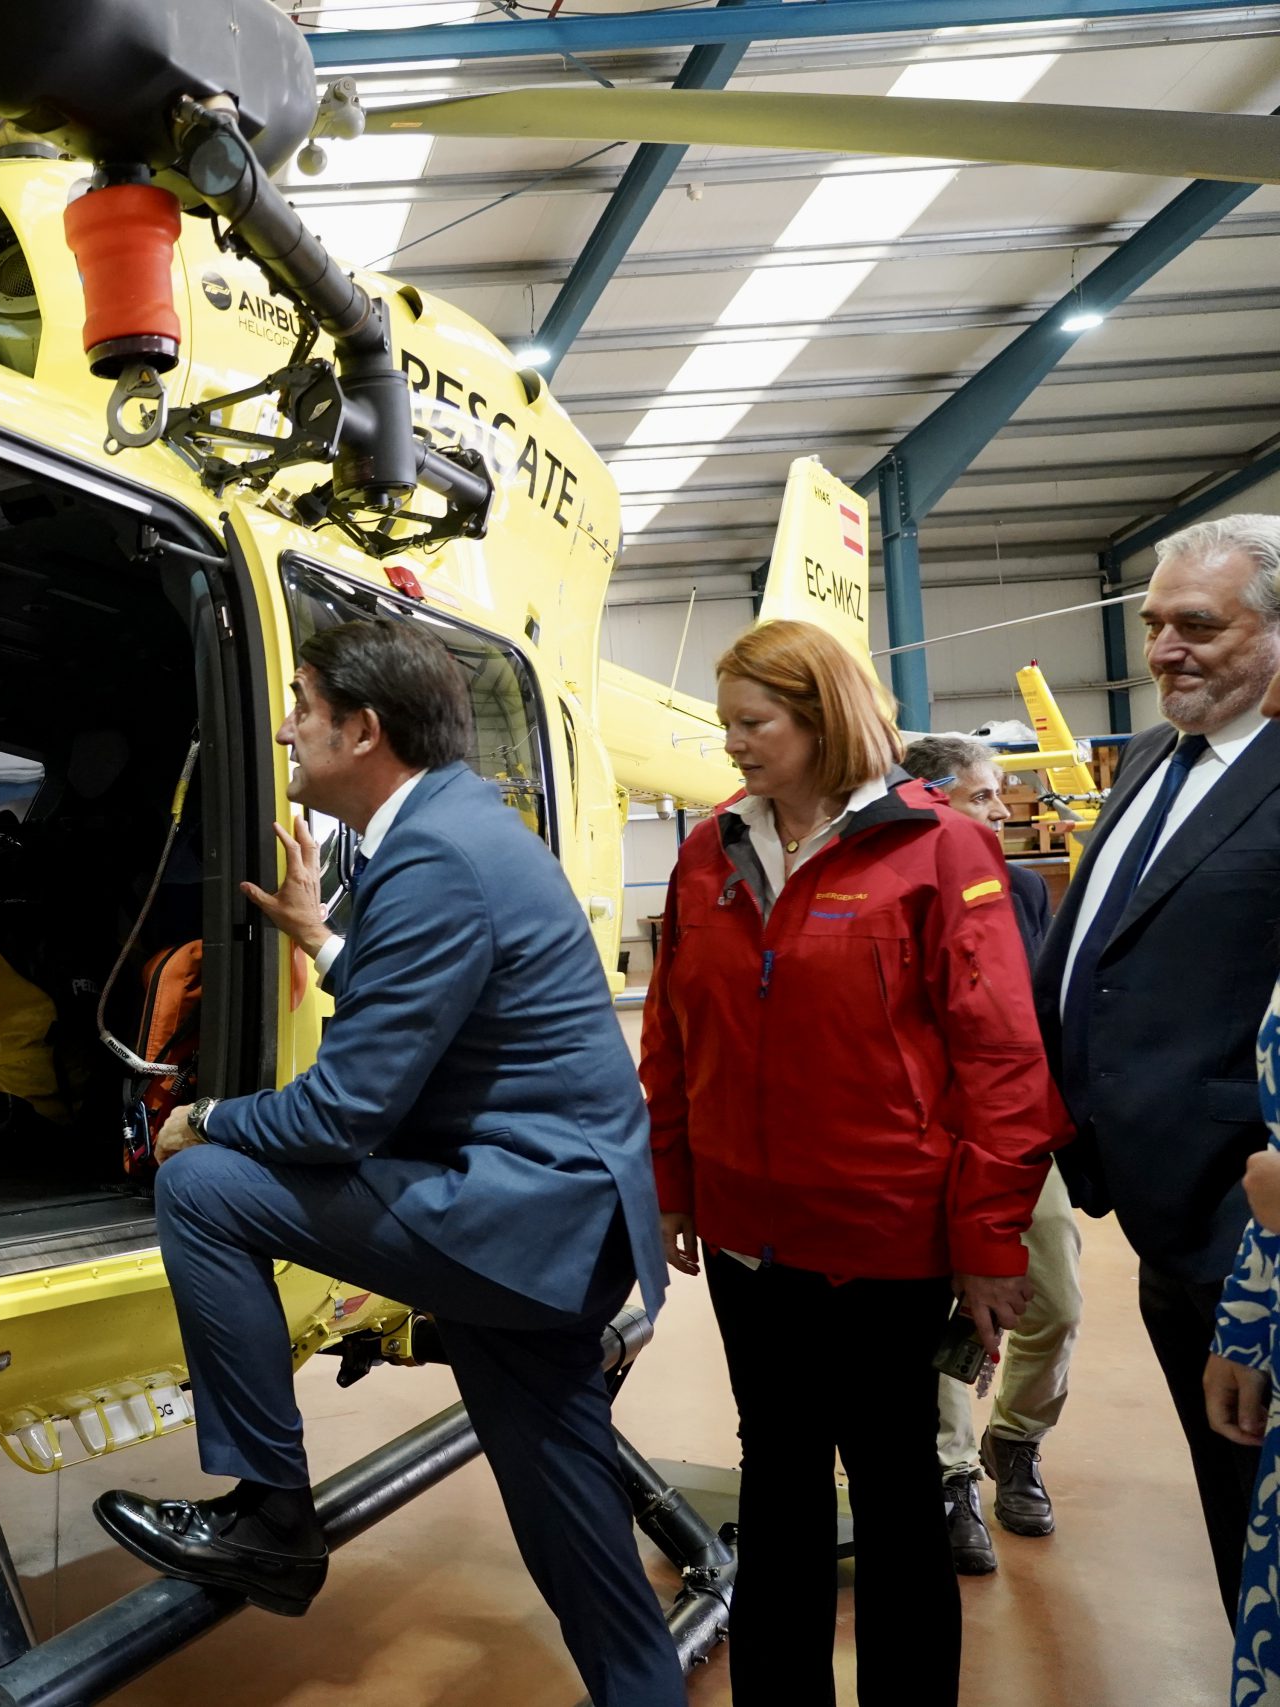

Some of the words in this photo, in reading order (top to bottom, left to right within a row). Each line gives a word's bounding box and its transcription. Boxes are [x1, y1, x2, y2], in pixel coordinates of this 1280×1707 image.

[238, 290, 301, 338] AIRBU
[238, 315, 298, 349] HELICOPT
[401, 348, 578, 529] RESCATE
[804, 556, 864, 622] EC-MKZ
[107, 1039, 130, 1059] FALLSTOP
